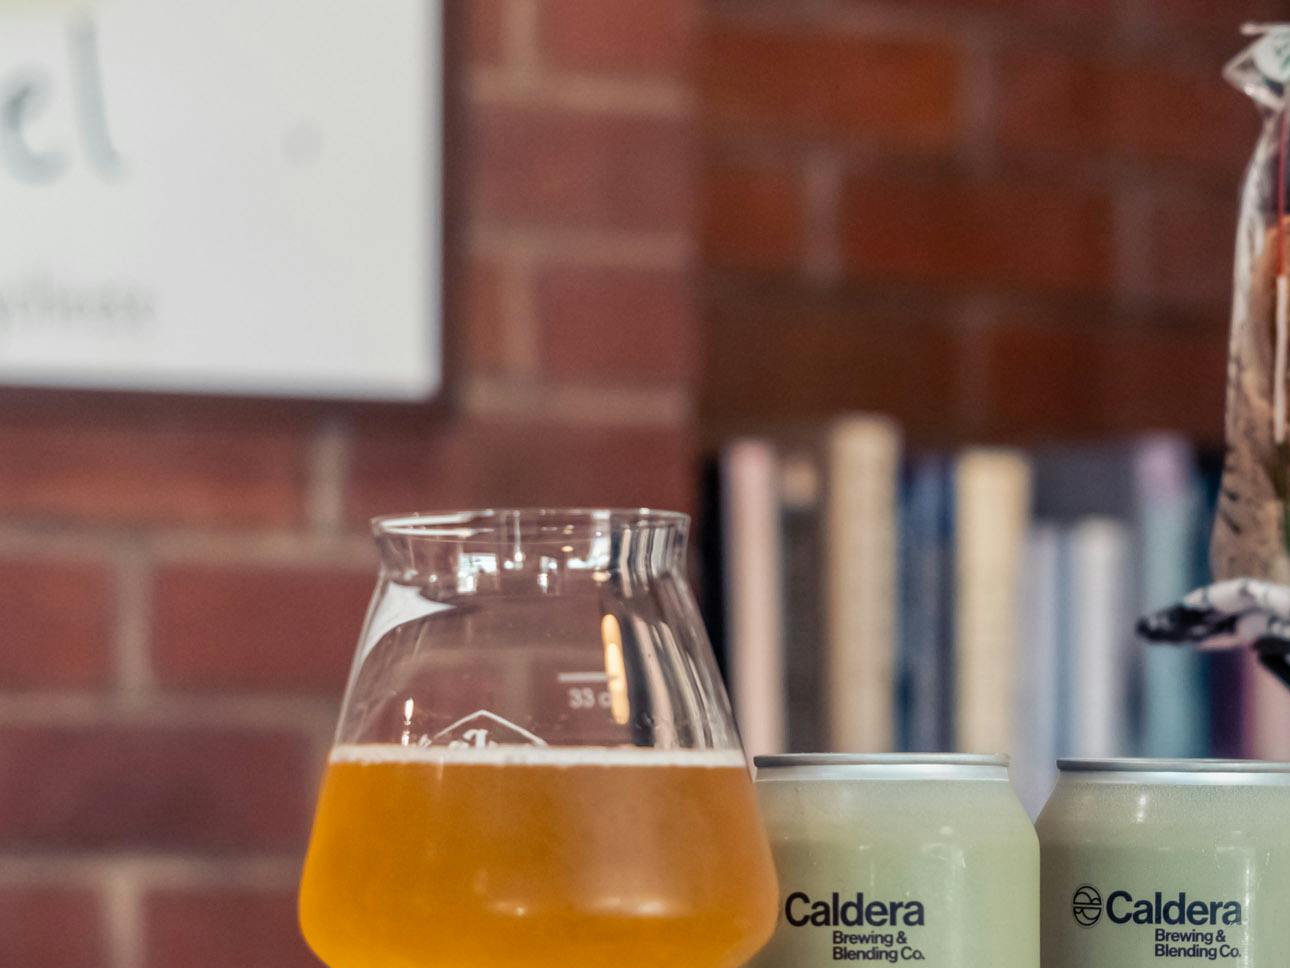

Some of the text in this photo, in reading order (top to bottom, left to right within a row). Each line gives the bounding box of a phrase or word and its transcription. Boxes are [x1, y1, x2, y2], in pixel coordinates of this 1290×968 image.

[785, 892, 925, 927] Caldera
[1106, 890, 1242, 925] Caldera
[832, 930, 907, 947] Brewing &
[1154, 928, 1226, 945] Brewing &
[832, 946, 926, 963] Blending Co.
[1154, 943, 1242, 960] Blending Co.
